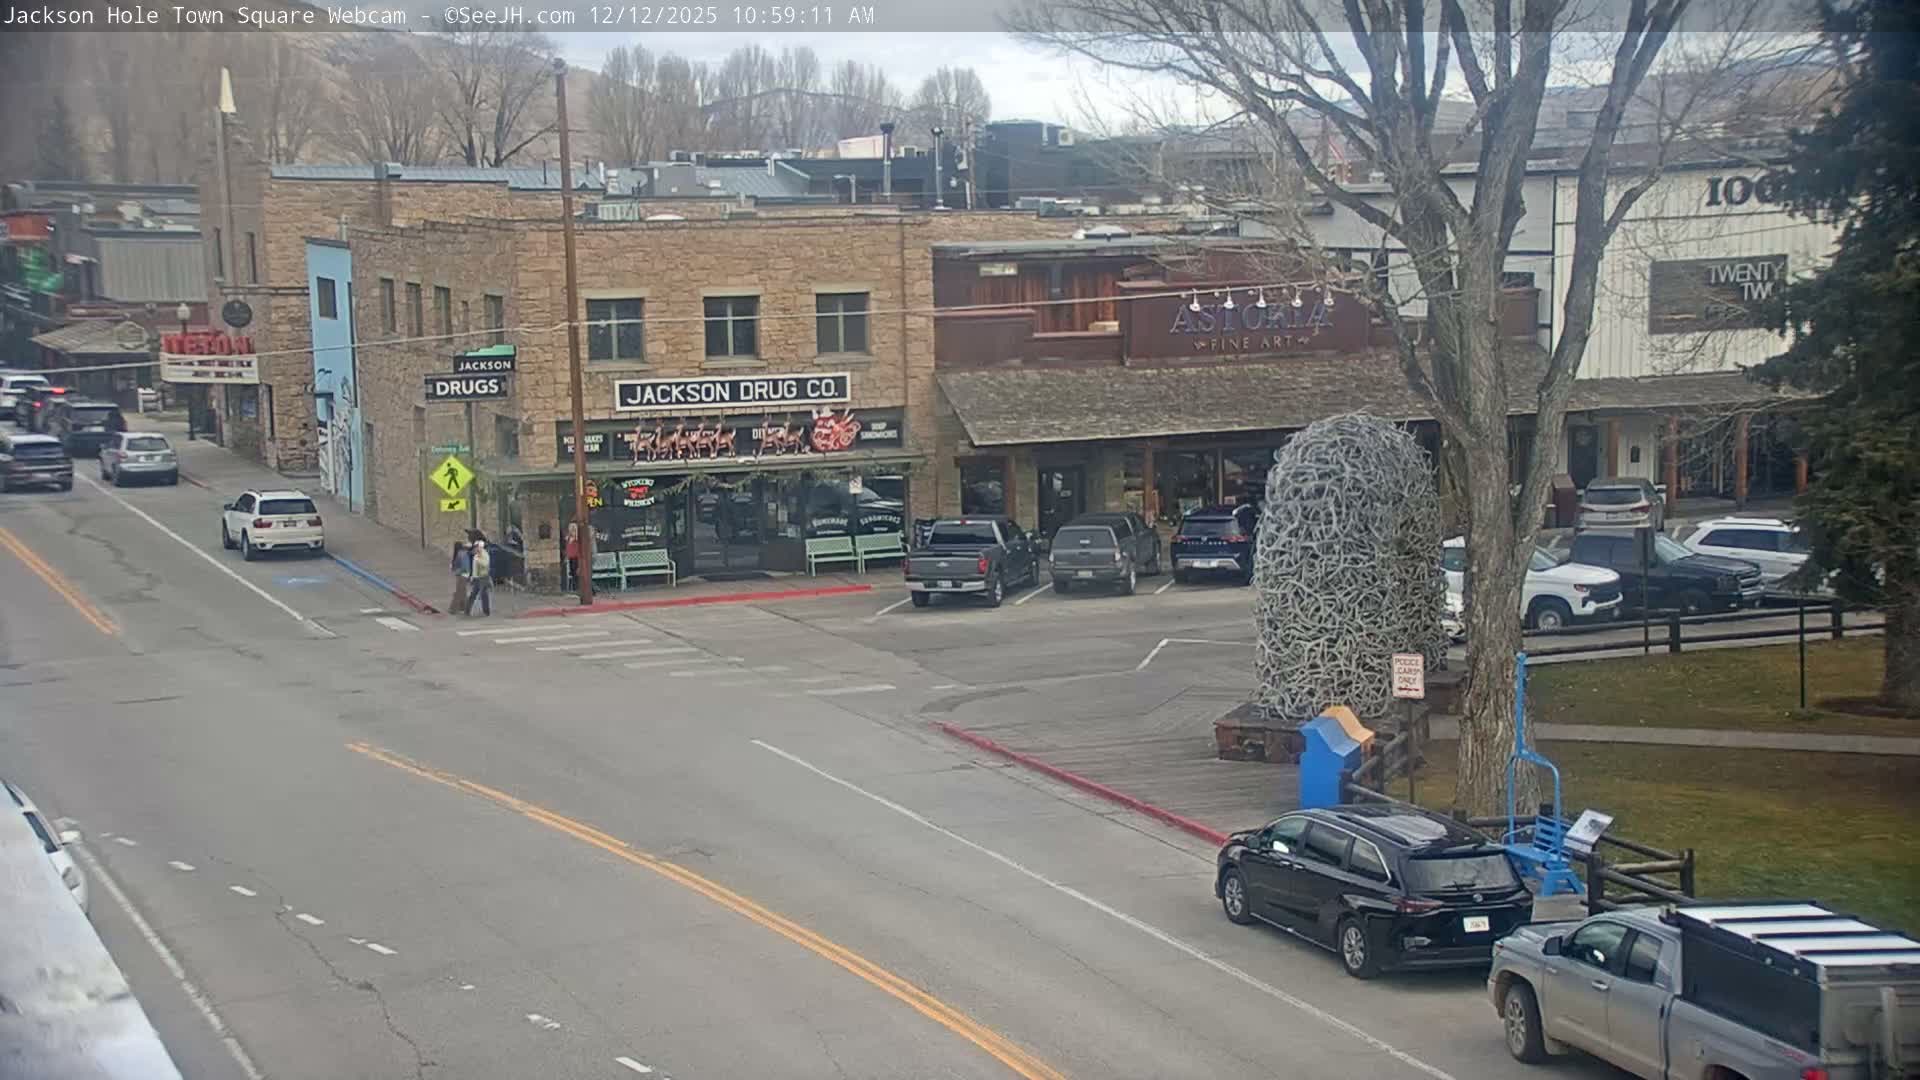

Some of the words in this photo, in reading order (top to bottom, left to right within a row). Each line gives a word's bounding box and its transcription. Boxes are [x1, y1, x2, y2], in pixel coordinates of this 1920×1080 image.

[1707, 261, 1785, 284] TWENTY
[1169, 303, 1334, 334] ASTORIA
[1210, 337, 1250, 351] FINE
[1260, 335, 1292, 349] ART
[458, 360, 512, 372] JACKSON
[435, 378, 499, 396] DRUGS
[626, 382, 730, 405] JACKSON
[739, 379, 798, 402] DRUG
[806, 378, 839, 398] CO.
